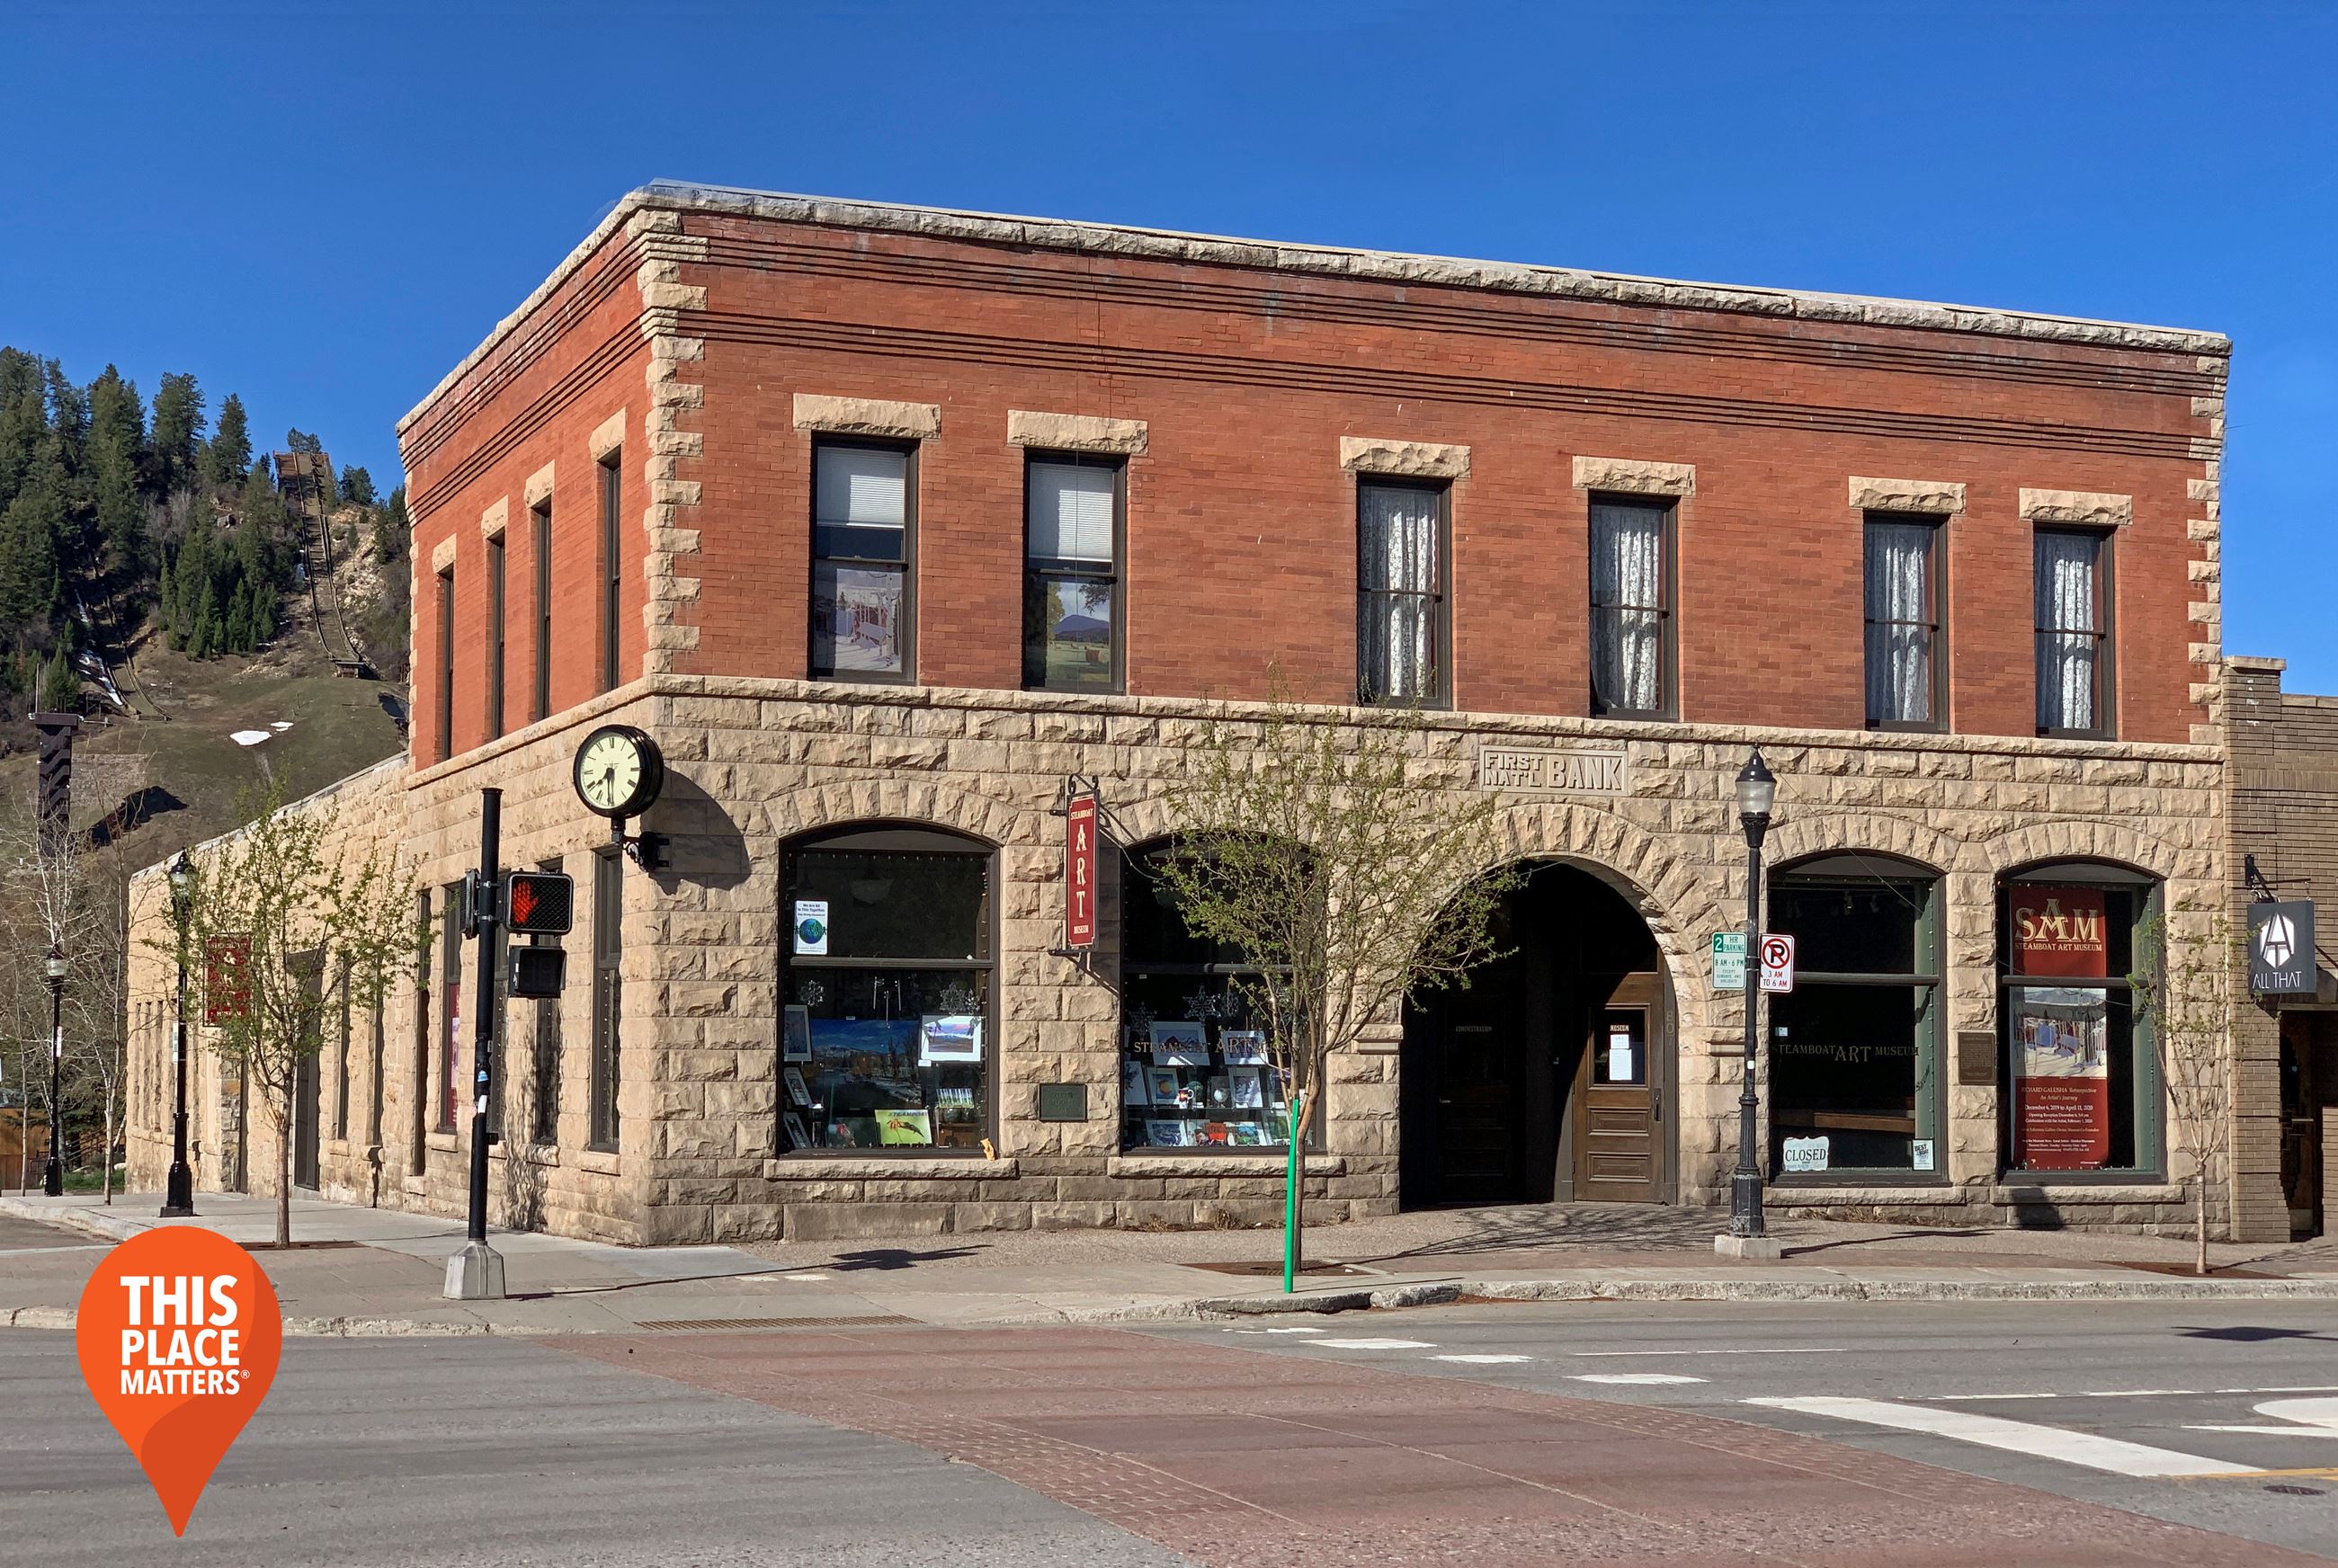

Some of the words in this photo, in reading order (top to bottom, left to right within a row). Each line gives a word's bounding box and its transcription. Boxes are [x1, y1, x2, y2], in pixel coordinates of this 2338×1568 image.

[1486, 753, 1543, 771] FIRST
[1486, 771, 1542, 788] NAT'L
[1548, 754, 1622, 791] BANK
[1070, 808, 1093, 820] STEAMBOAT
[1075, 824, 1087, 918] ART
[1715, 937, 1722, 951] 2
[1724, 944, 1745, 952] PARKING
[2014, 943, 2057, 951] STEAMBOAT
[2057, 943, 2072, 951] ART
[2074, 944, 2102, 952] MUSEUM
[1763, 978, 1771, 986] TO
[1772, 979, 1777, 987] 6
[2252, 972, 2270, 990] ALL
[2272, 971, 2302, 988] THAT
[1610, 1024, 1629, 1032] MUSEUM
[1772, 1044, 1836, 1056] STEAMBOAT
[1834, 1046, 1871, 1063] ART
[1875, 1046, 1919, 1056] MUSEUM
[1785, 1148, 1826, 1162] CLOSED
